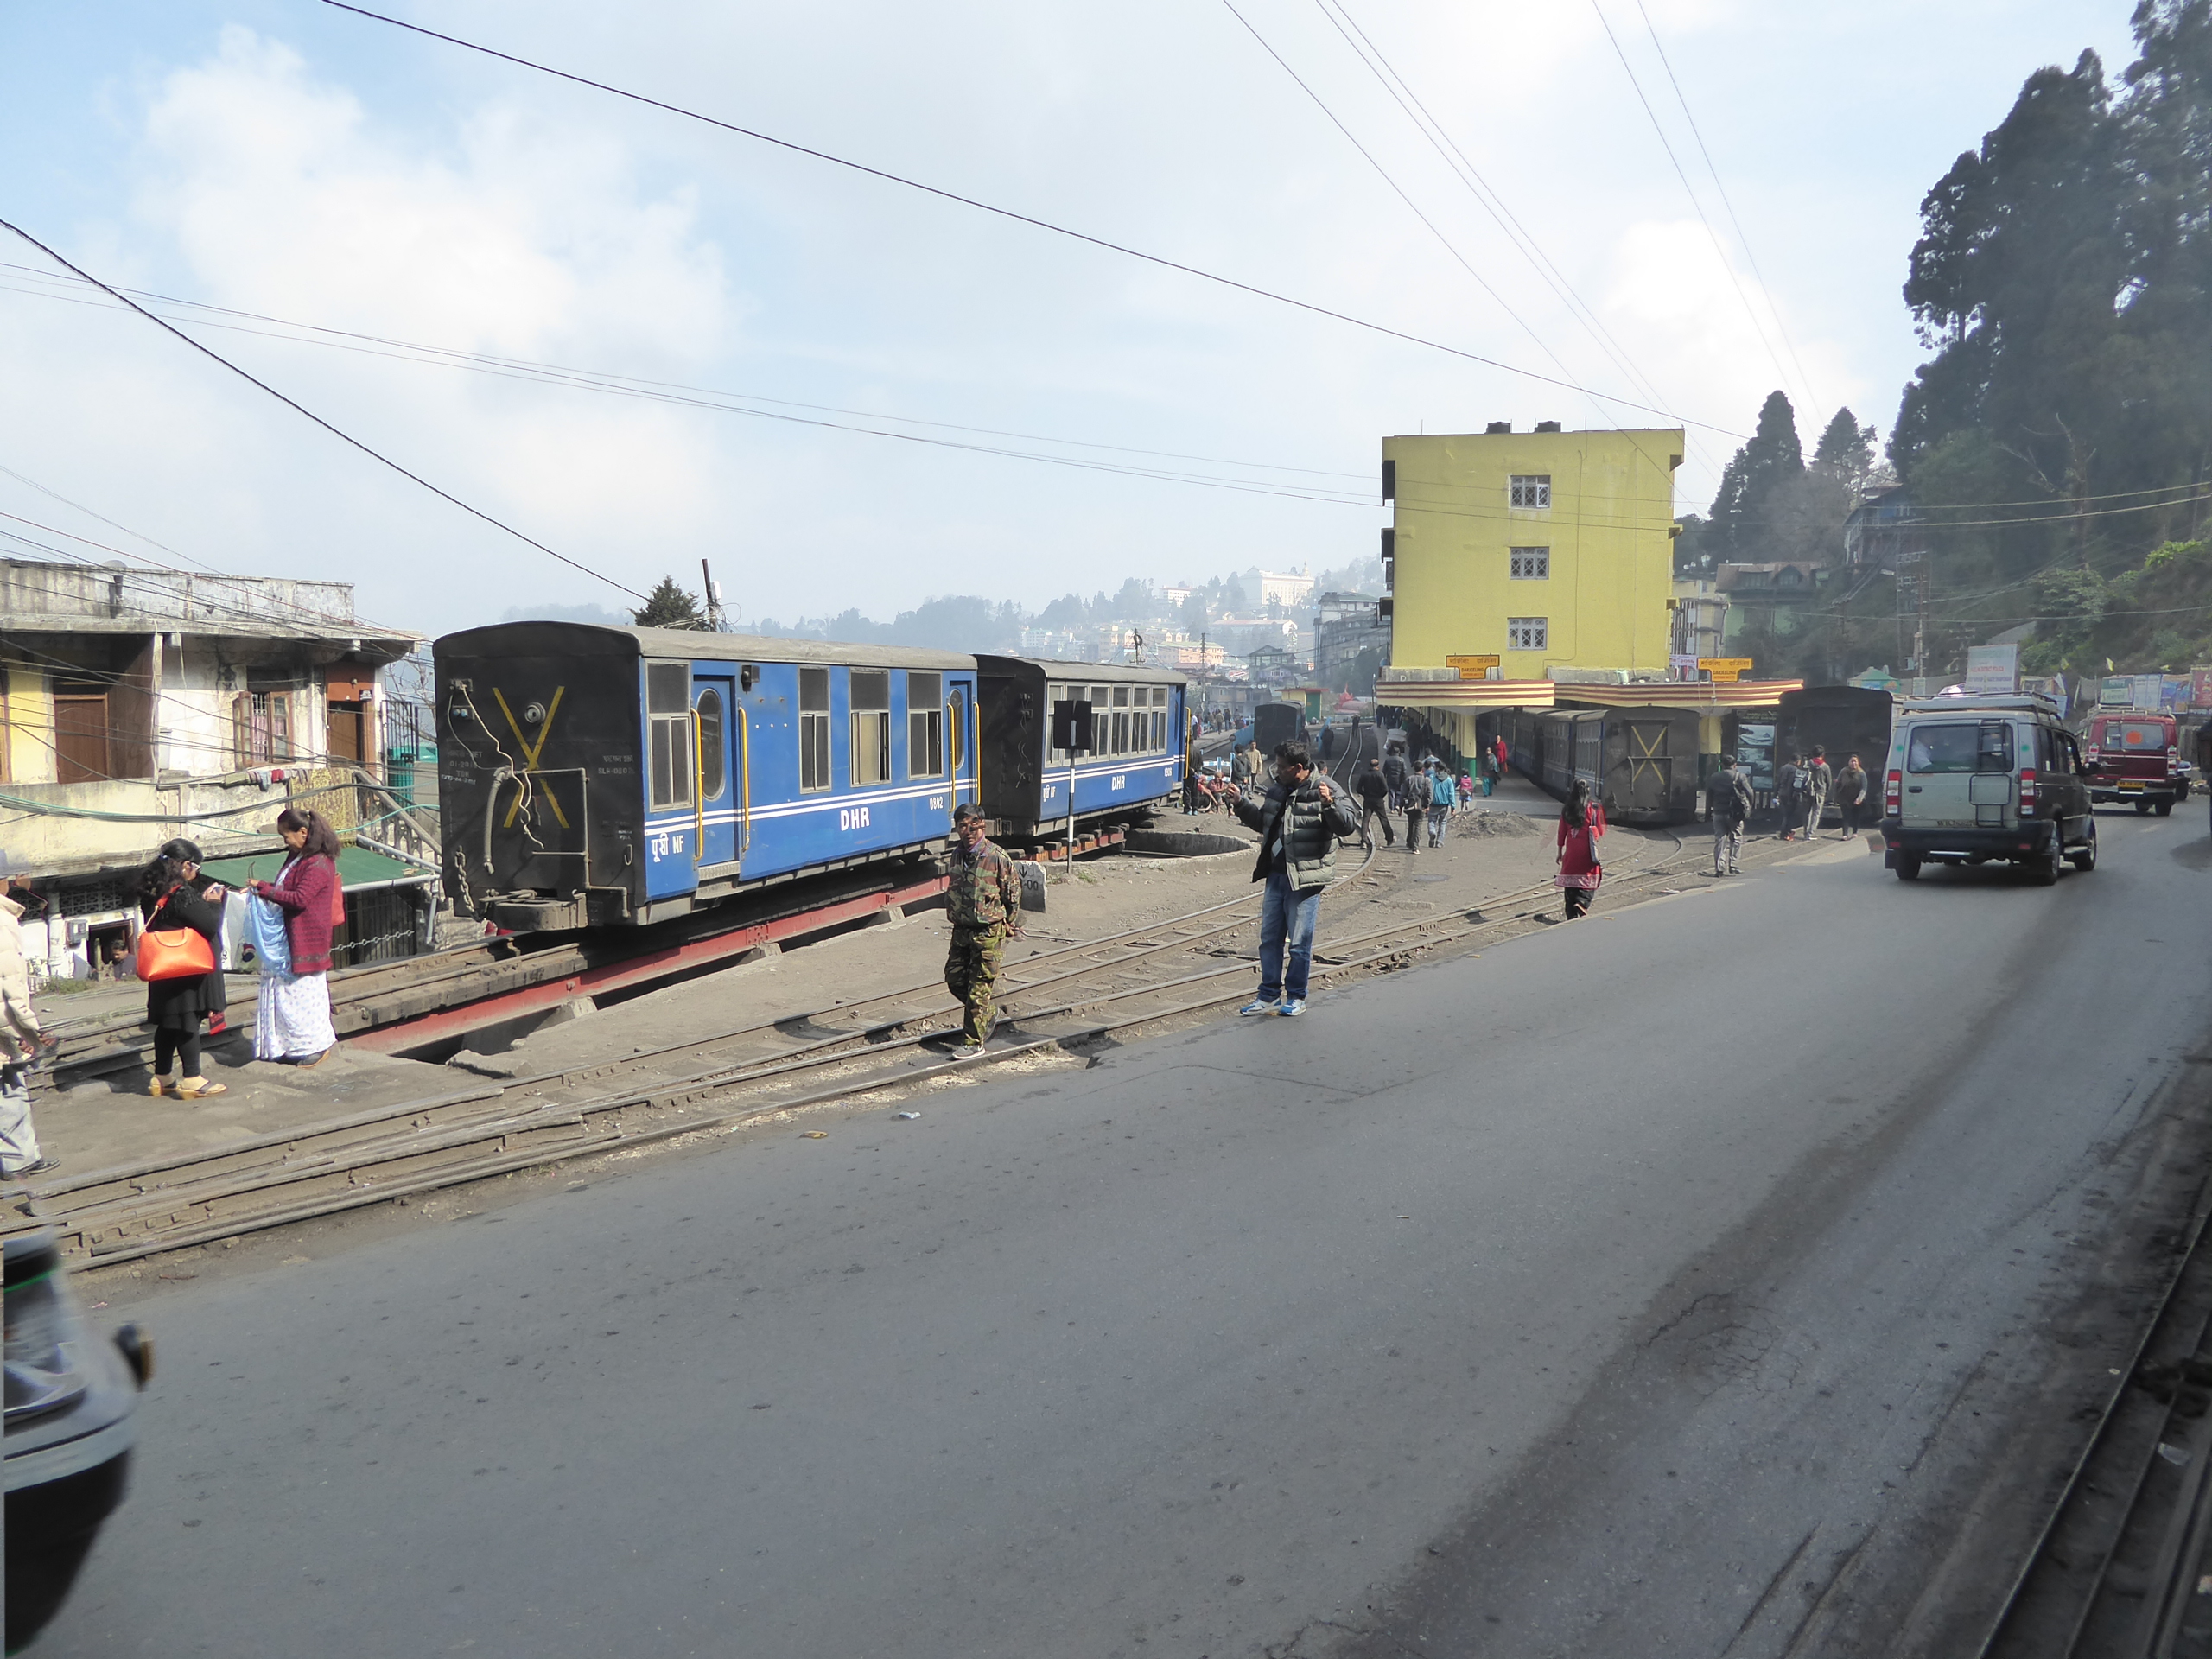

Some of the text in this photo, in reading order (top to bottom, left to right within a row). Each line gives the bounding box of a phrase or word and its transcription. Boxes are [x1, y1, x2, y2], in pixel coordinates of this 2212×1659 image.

[1051, 785, 1056, 798] NF
[1111, 774, 1126, 791] DHR
[840, 806, 870, 832] DHR
[672, 835, 684, 855] NF
